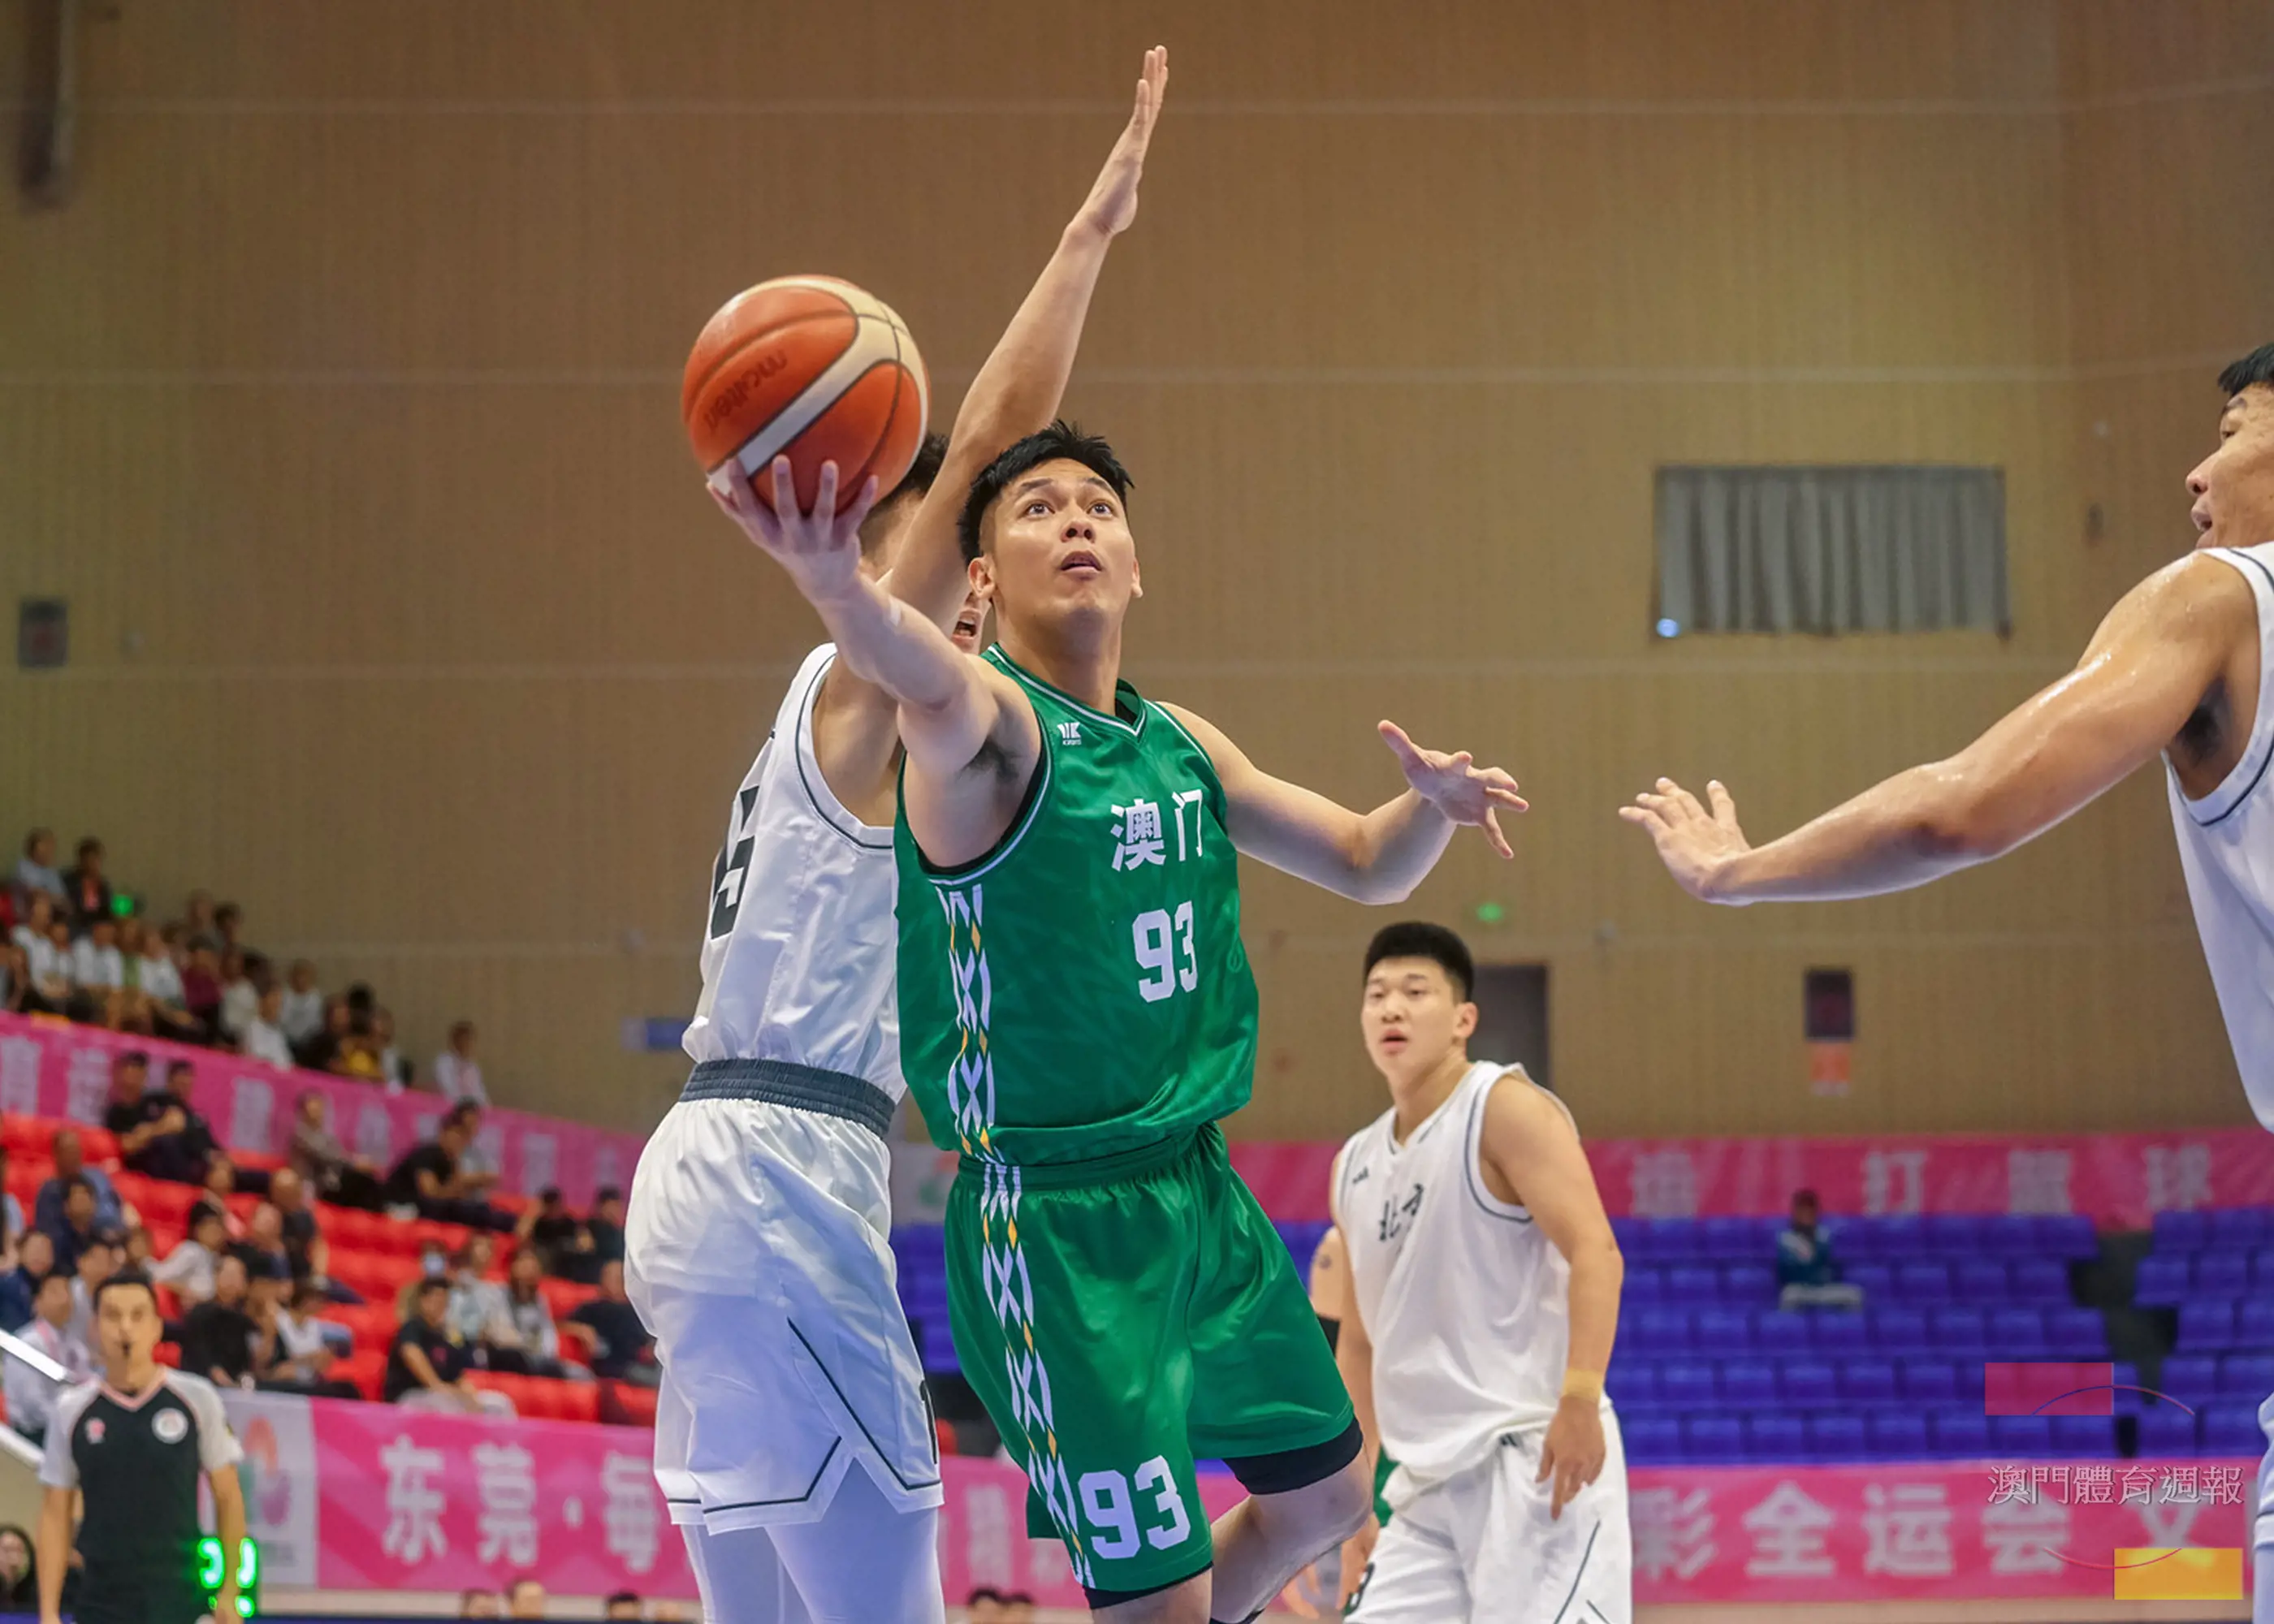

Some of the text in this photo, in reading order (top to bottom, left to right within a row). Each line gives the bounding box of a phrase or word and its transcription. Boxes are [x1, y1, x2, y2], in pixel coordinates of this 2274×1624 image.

[1109, 788, 1204, 872] 澳门
[1131, 900, 1199, 1004] 93
[1077, 1454, 1191, 1560] 93
